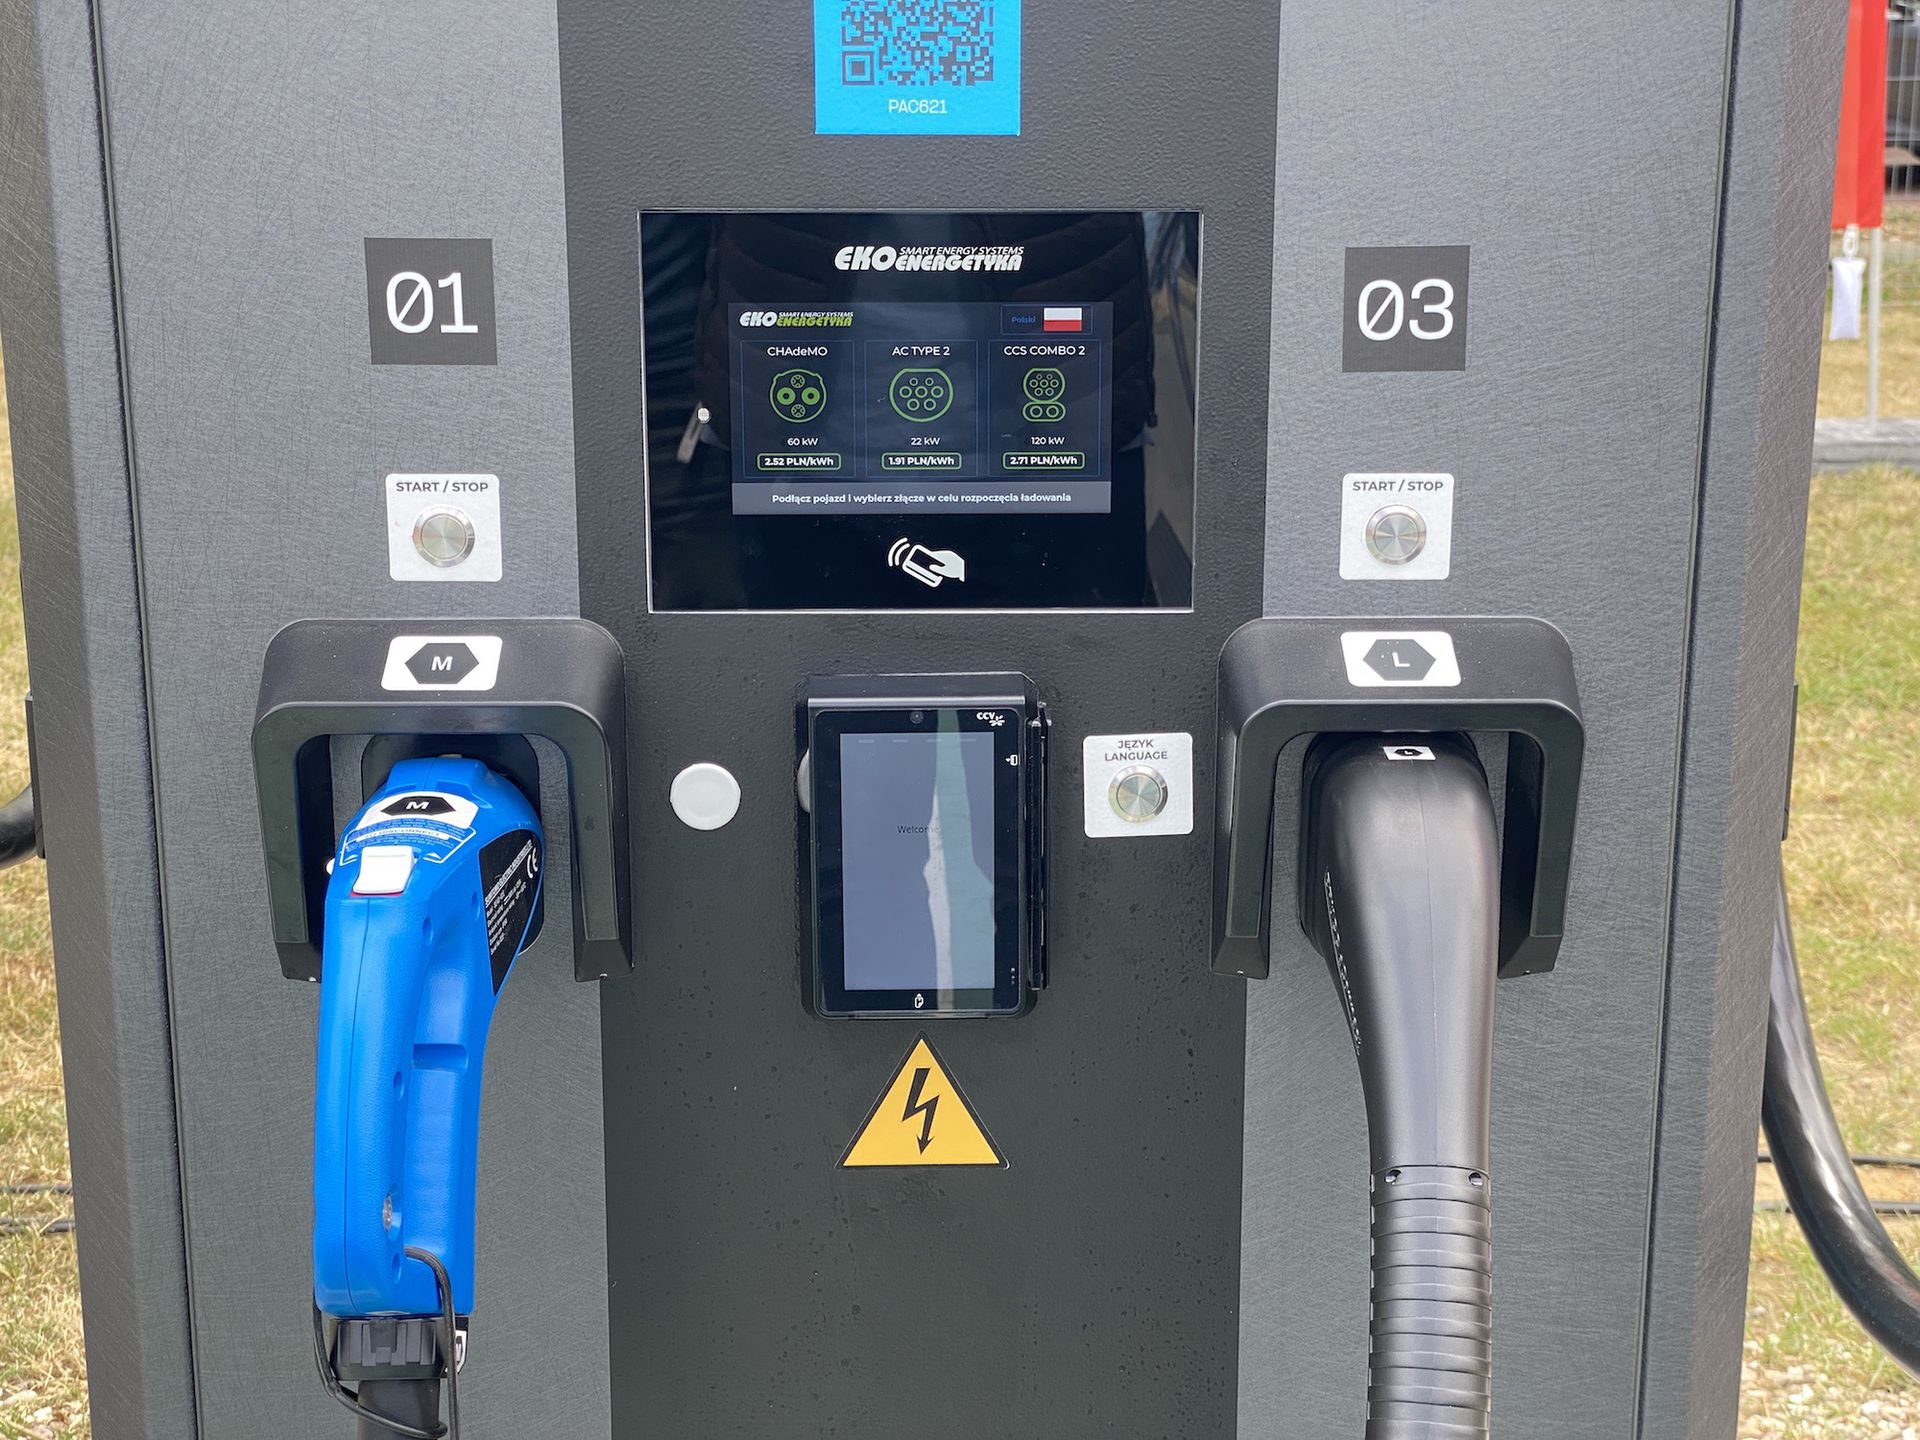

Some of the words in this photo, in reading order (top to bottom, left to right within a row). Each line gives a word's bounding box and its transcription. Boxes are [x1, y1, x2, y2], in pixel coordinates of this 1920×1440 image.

[888, 99, 947, 114] PAC621
[899, 246, 936, 255] SMART
[937, 246, 976, 255] ENERGY
[978, 246, 1024, 255] SYSTEMS
[834, 246, 897, 271] EKO
[895, 254, 1022, 271] ENERGETYKA
[385, 271, 478, 334] 01
[1357, 278, 1454, 341] 03
[739, 311, 778, 327] EKO
[776, 317, 853, 327] ENERGETYKA
[1011, 315, 1036, 325] Polski
[767, 346, 828, 356] CHAdeMO
[891, 346, 910, 356] AC
[911, 346, 941, 356] TYPE
[943, 346, 951, 355] 2
[1003, 346, 1027, 356] CCS
[1029, 346, 1076, 356] COMBO
[1078, 345, 1086, 355] 2
[787, 437, 800, 446] 60
[802, 437, 819, 446] kW
[910, 437, 922, 446] 22
[924, 437, 941, 446] kW
[1031, 436, 1047, 445] 120
[1048, 436, 1065, 445] kW
[764, 457, 785, 466] 2.52
[786, 456, 834, 467] PLN/kWh
[888, 456, 905, 466] 1.91
[907, 456, 955, 467] PLN/kWh
[1010, 456, 1028, 465] 2.71
[1030, 456, 1078, 466] PLN/kWh
[395, 481, 440, 493] START
[442, 480, 449, 493] /
[451, 481, 489, 493] STOP
[1352, 480, 1396, 492] START
[1398, 479, 1405, 493] /
[1407, 480, 1444, 492] STOP
[772, 494, 812, 505] Podłącz
[813, 494, 846, 505] pojazd
[853, 494, 892, 505] wybierz
[894, 494, 925, 505] złącze
[926, 494, 936, 502] w
[938, 493, 959, 502] celu
[961, 493, 1018, 504] rozpoczęcia
[1020, 493, 1071, 502] ładowania
[430, 656, 453, 671] M
[1392, 652, 1410, 667] L
[976, 712, 996, 720] CCV
[1118, 739, 1154, 751] JĘZYK
[1104, 751, 1168, 761] LANGUAGE
[405, 801, 430, 810] M
[897, 825, 940, 833] Welcome
